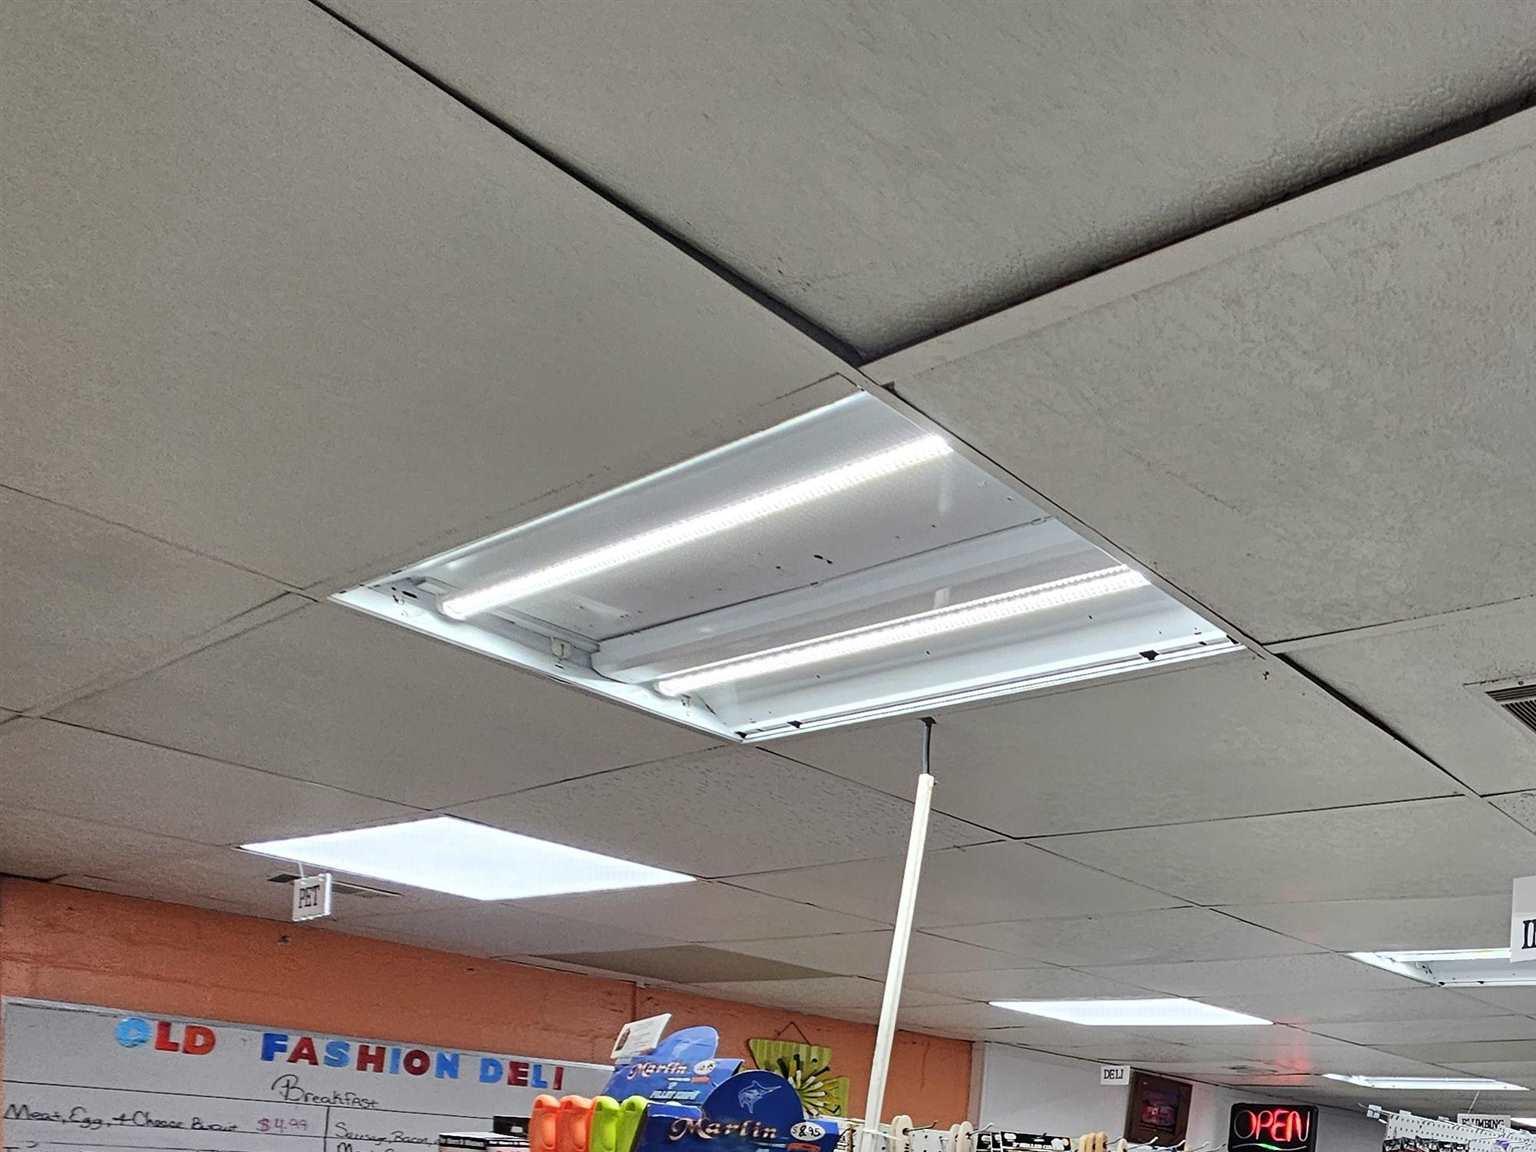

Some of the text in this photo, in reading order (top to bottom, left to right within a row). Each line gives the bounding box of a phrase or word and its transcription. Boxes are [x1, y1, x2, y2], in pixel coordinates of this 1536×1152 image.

[115, 1016, 565, 1091] OLD FASHION DELI
[627, 1060, 688, 1080] Marlin
[1103, 1069, 1124, 1080] DELI
[668, 1117, 777, 1142] Marlin
[1233, 1107, 1311, 1143] OPEN
